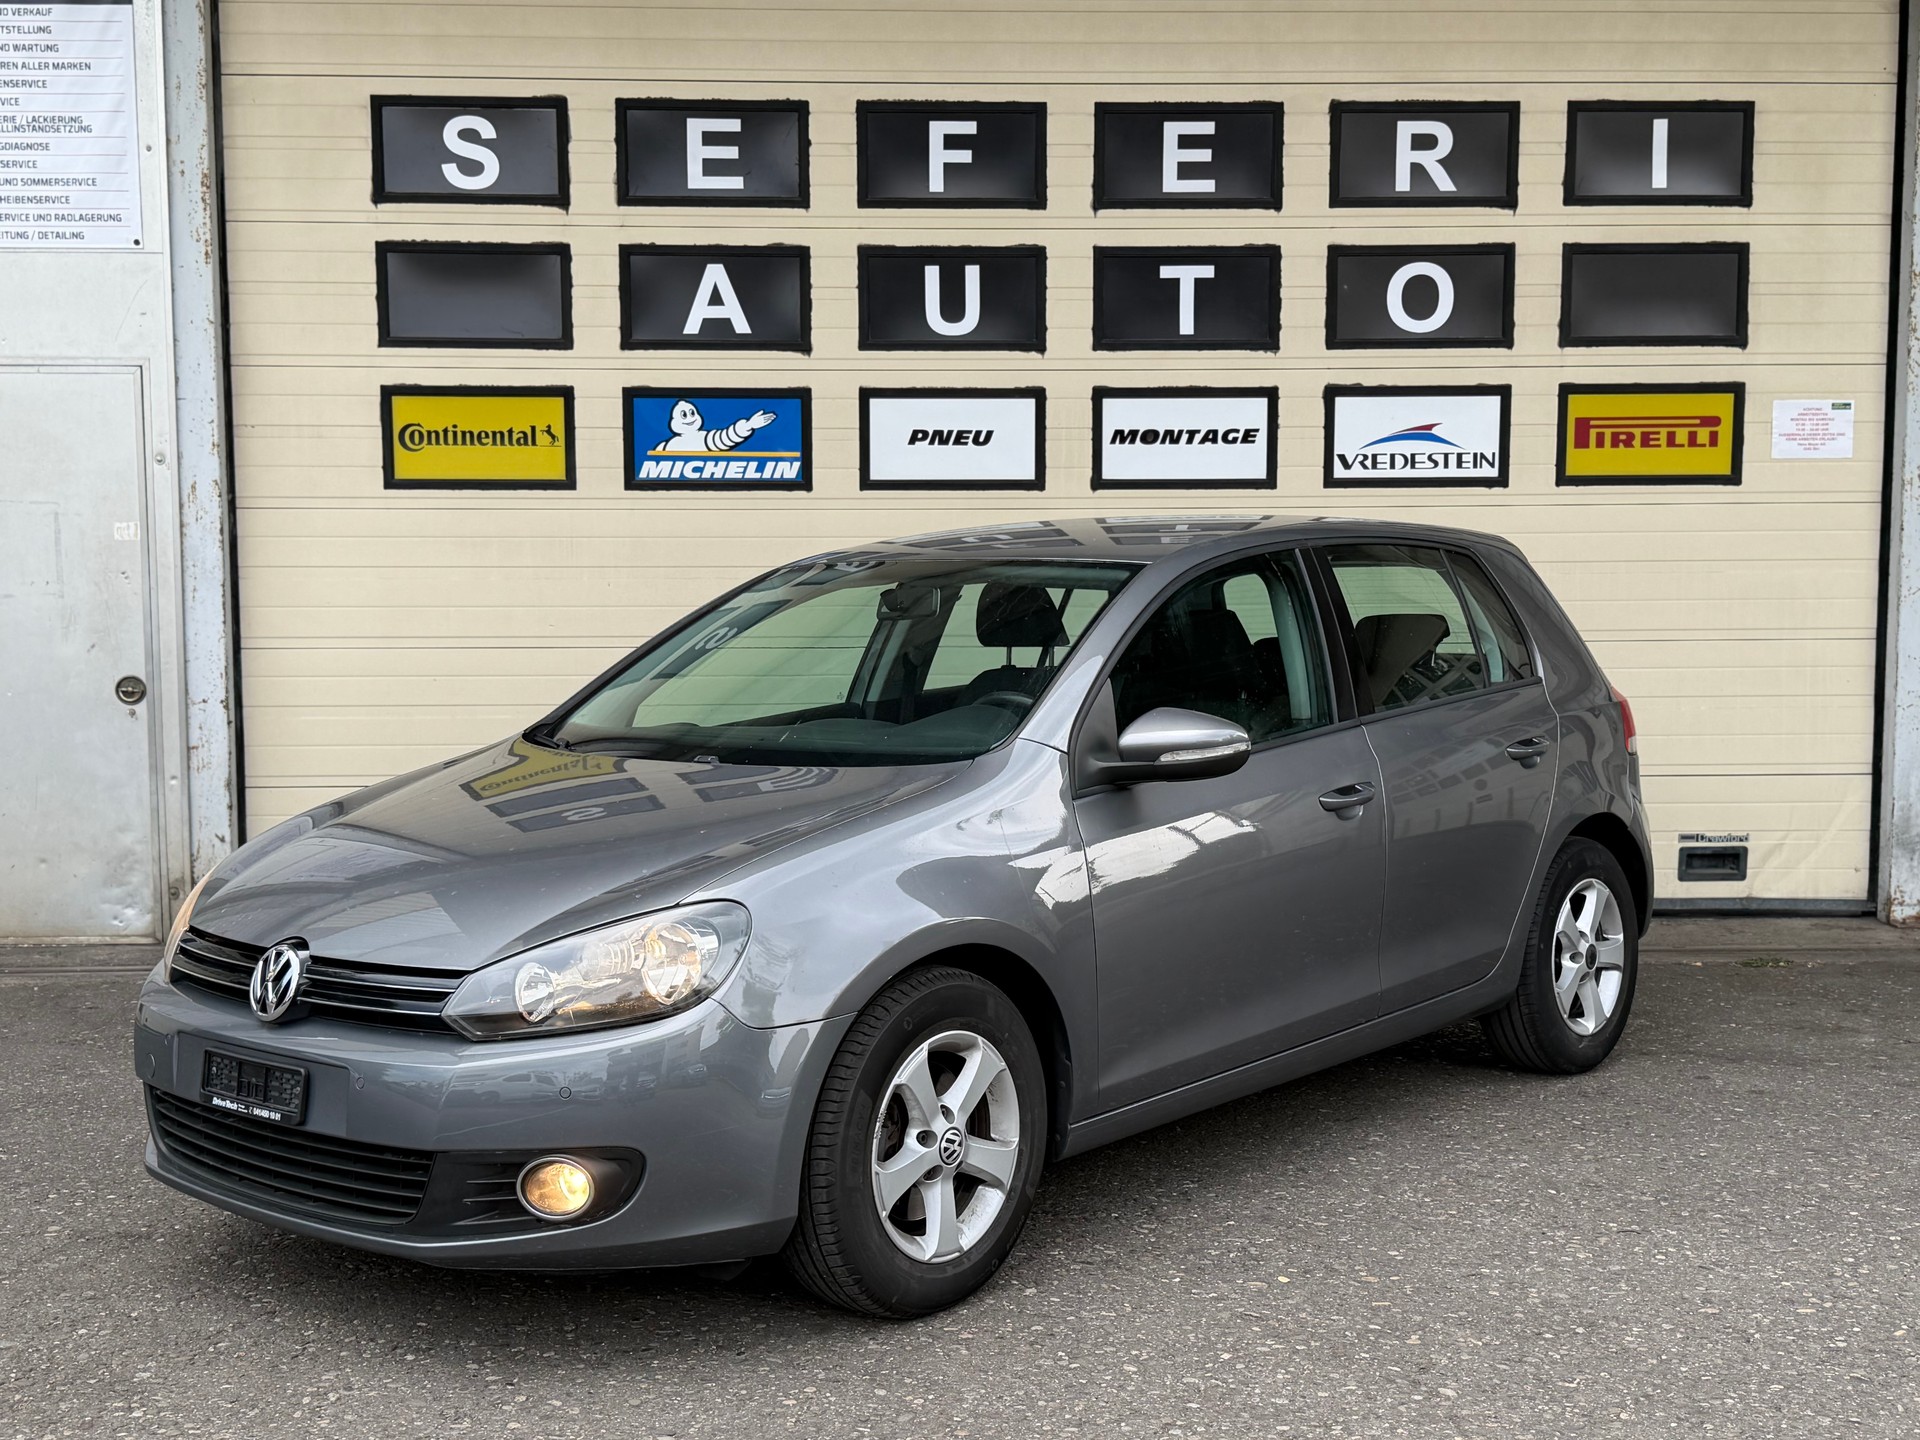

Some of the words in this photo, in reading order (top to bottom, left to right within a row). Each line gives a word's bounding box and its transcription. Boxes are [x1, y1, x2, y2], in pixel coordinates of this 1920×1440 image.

[11, 8, 53, 16] VERKAUF
[12, 44, 59, 52] WARTUNG
[20, 62, 50, 70] ALLER
[52, 62, 91, 71] MARKEN
[26, 116, 83, 124] LACKIERUNG
[0, 125, 93, 133] LLINSTANDSETZUNG
[0, 160, 38, 168] SERVICE
[20, 178, 98, 186] SOMMERSERVICE
[32, 213, 52, 222] UND
[54, 213, 122, 222] RADLAGERUNG
[0, 231, 29, 240] ITUNG
[38, 231, 85, 240] DETAILING
[682, 262, 1454, 336] AUTO
[398, 422, 538, 452] Continental
[1109, 428, 1260, 446] MONTAGE
[1574, 416, 1722, 449] PIRELLI
[907, 429, 995, 446] PNEU
[1336, 452, 1496, 471] VREDESTEIN
[638, 460, 801, 479] MICHELIN
[1696, 833, 1749, 842] Crawford
